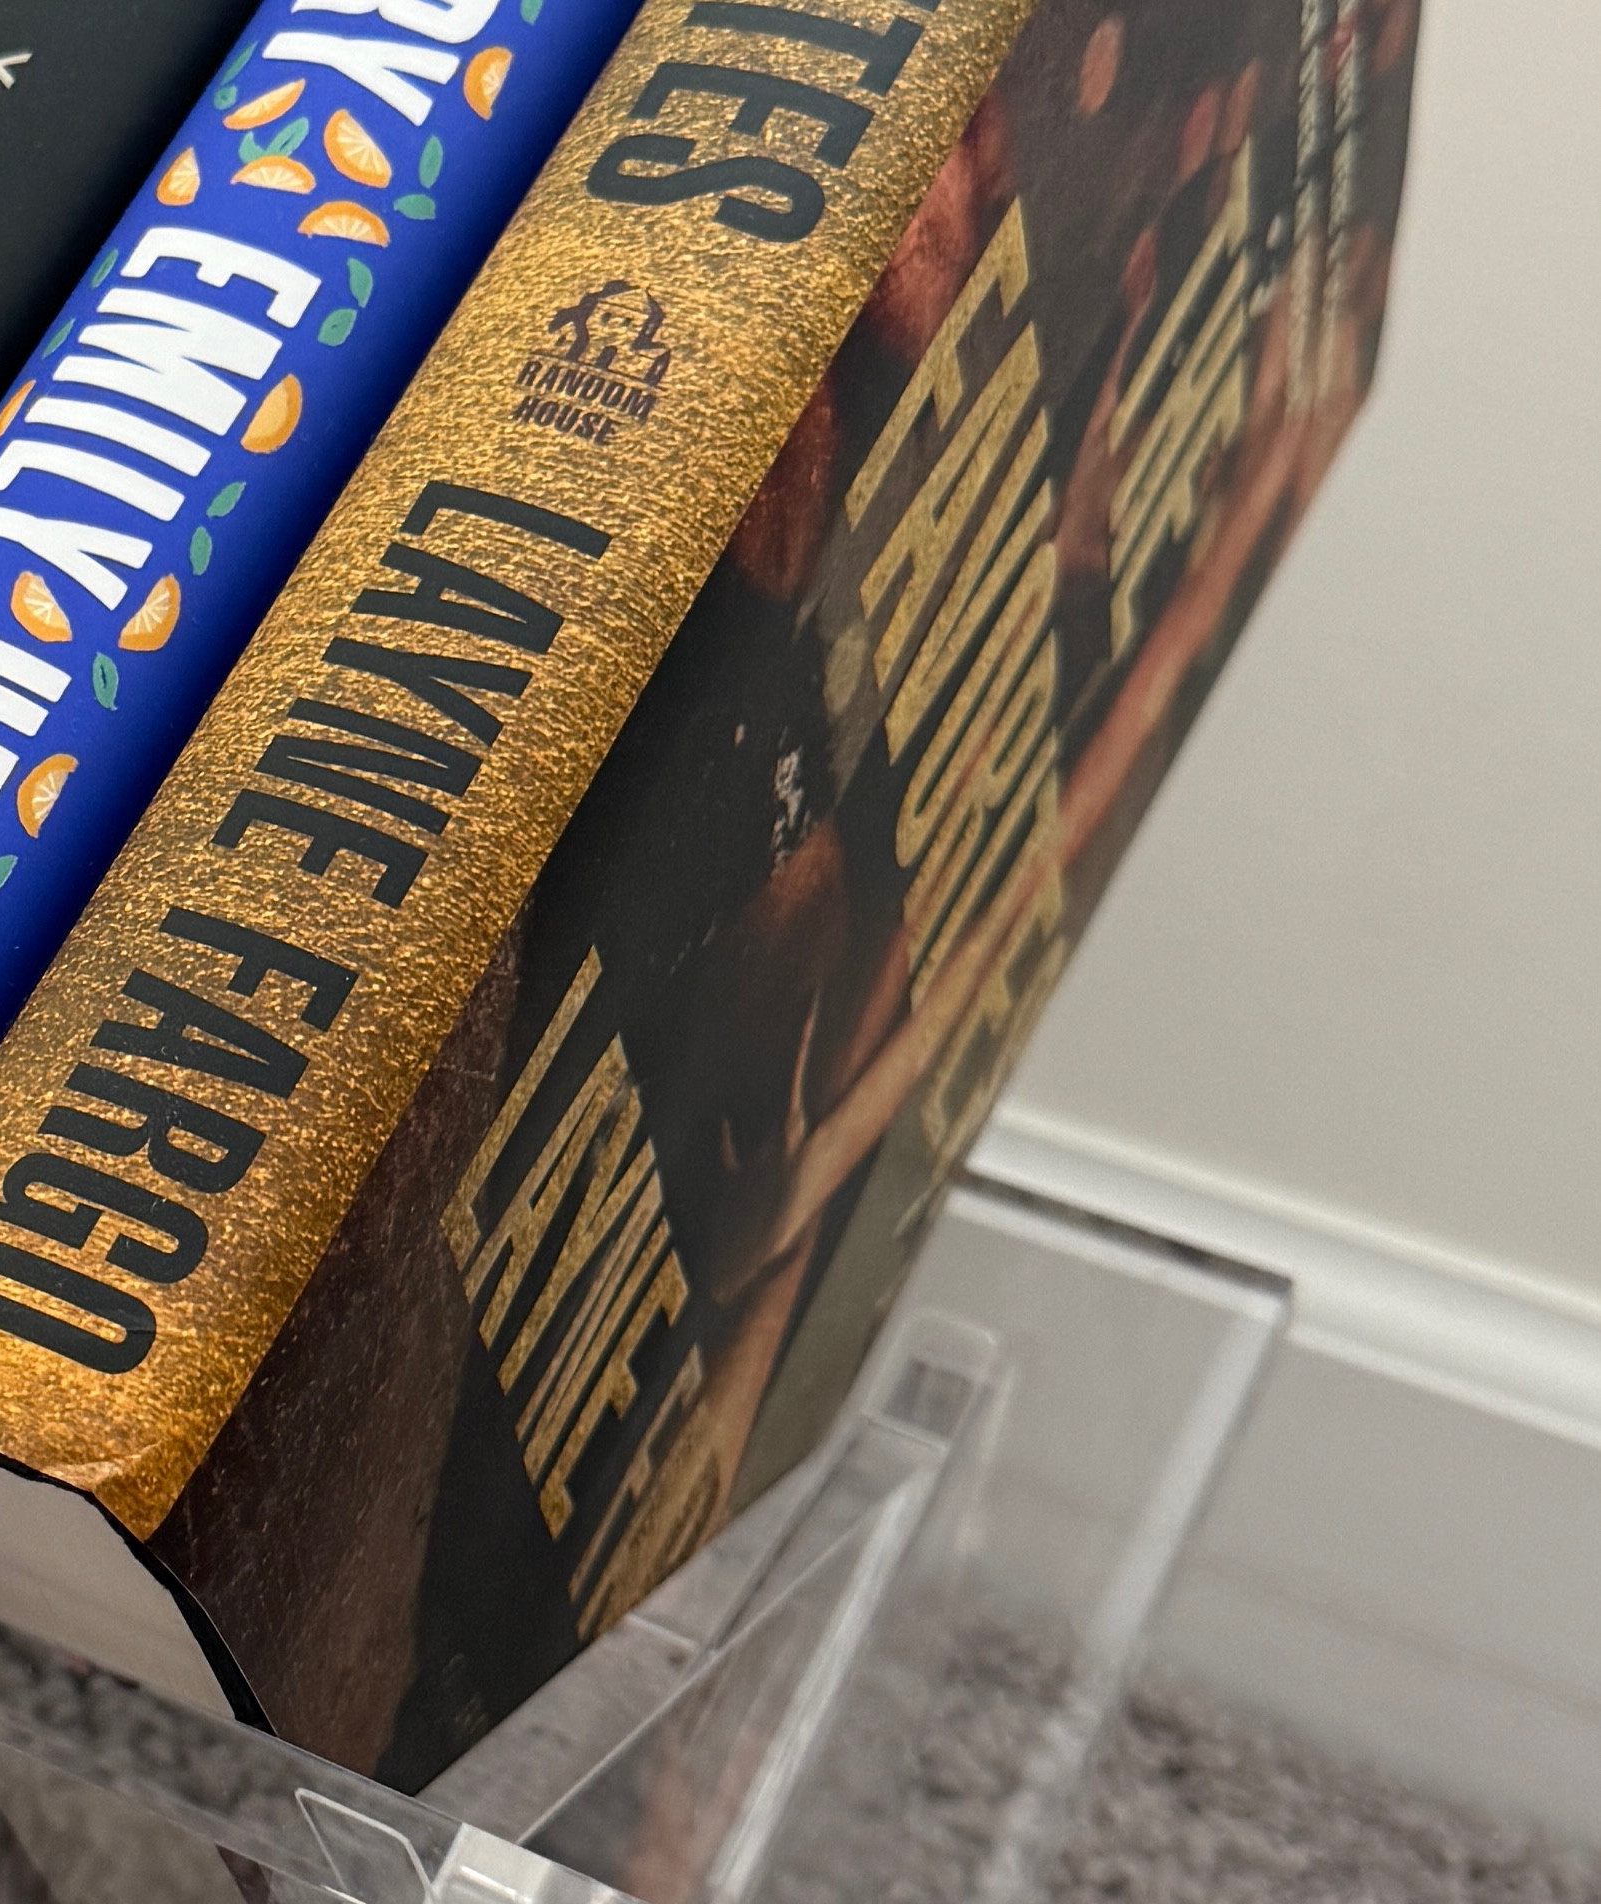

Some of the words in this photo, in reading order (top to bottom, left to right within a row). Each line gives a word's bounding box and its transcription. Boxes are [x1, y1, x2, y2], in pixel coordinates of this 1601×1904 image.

[509, 393, 621, 448] HOUSE
[514, 359, 655, 424] RANDOM
[1107, 133, 1256, 664] THE
[210, 479, 613, 908] LAYNE
[439, 944, 689, 1541] LAYNE
